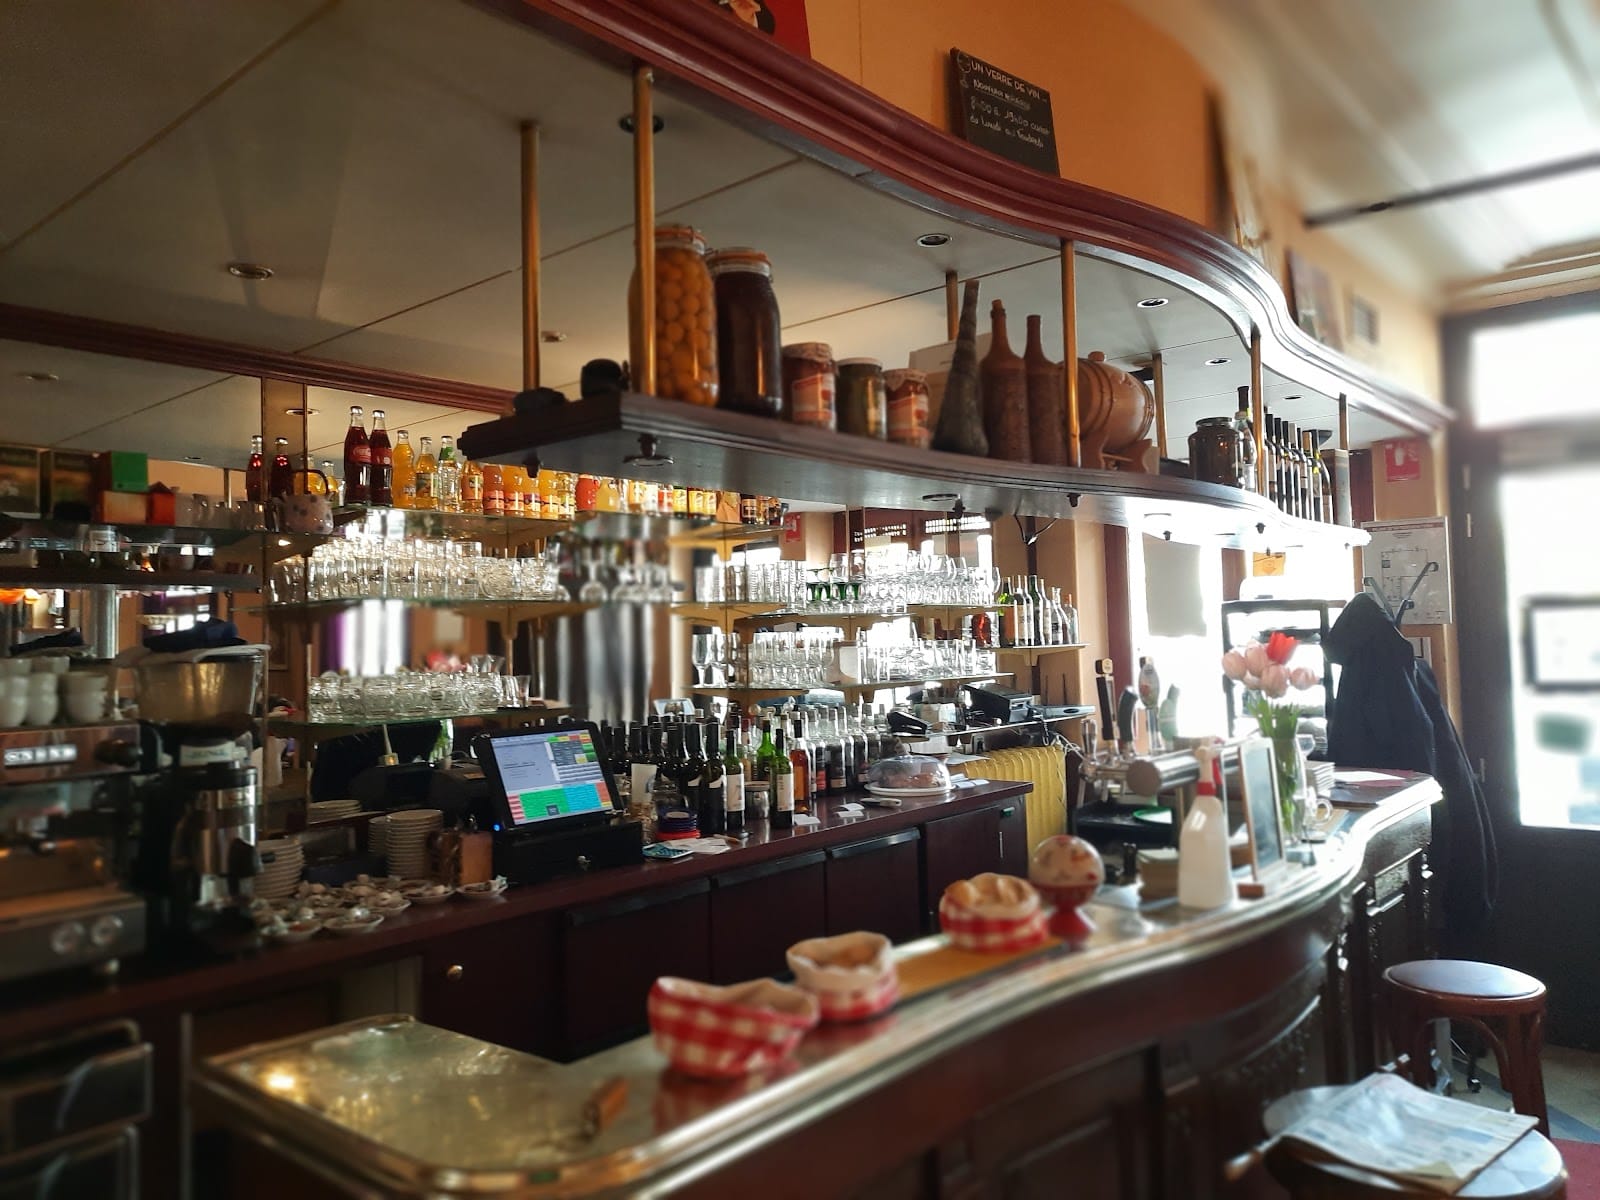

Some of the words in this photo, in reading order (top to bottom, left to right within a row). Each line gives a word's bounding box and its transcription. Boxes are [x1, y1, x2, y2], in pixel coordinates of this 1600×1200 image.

[971, 60, 984, 73] UN
[985, 68, 1013, 87] VERRE
[1014, 80, 1026, 93] DE
